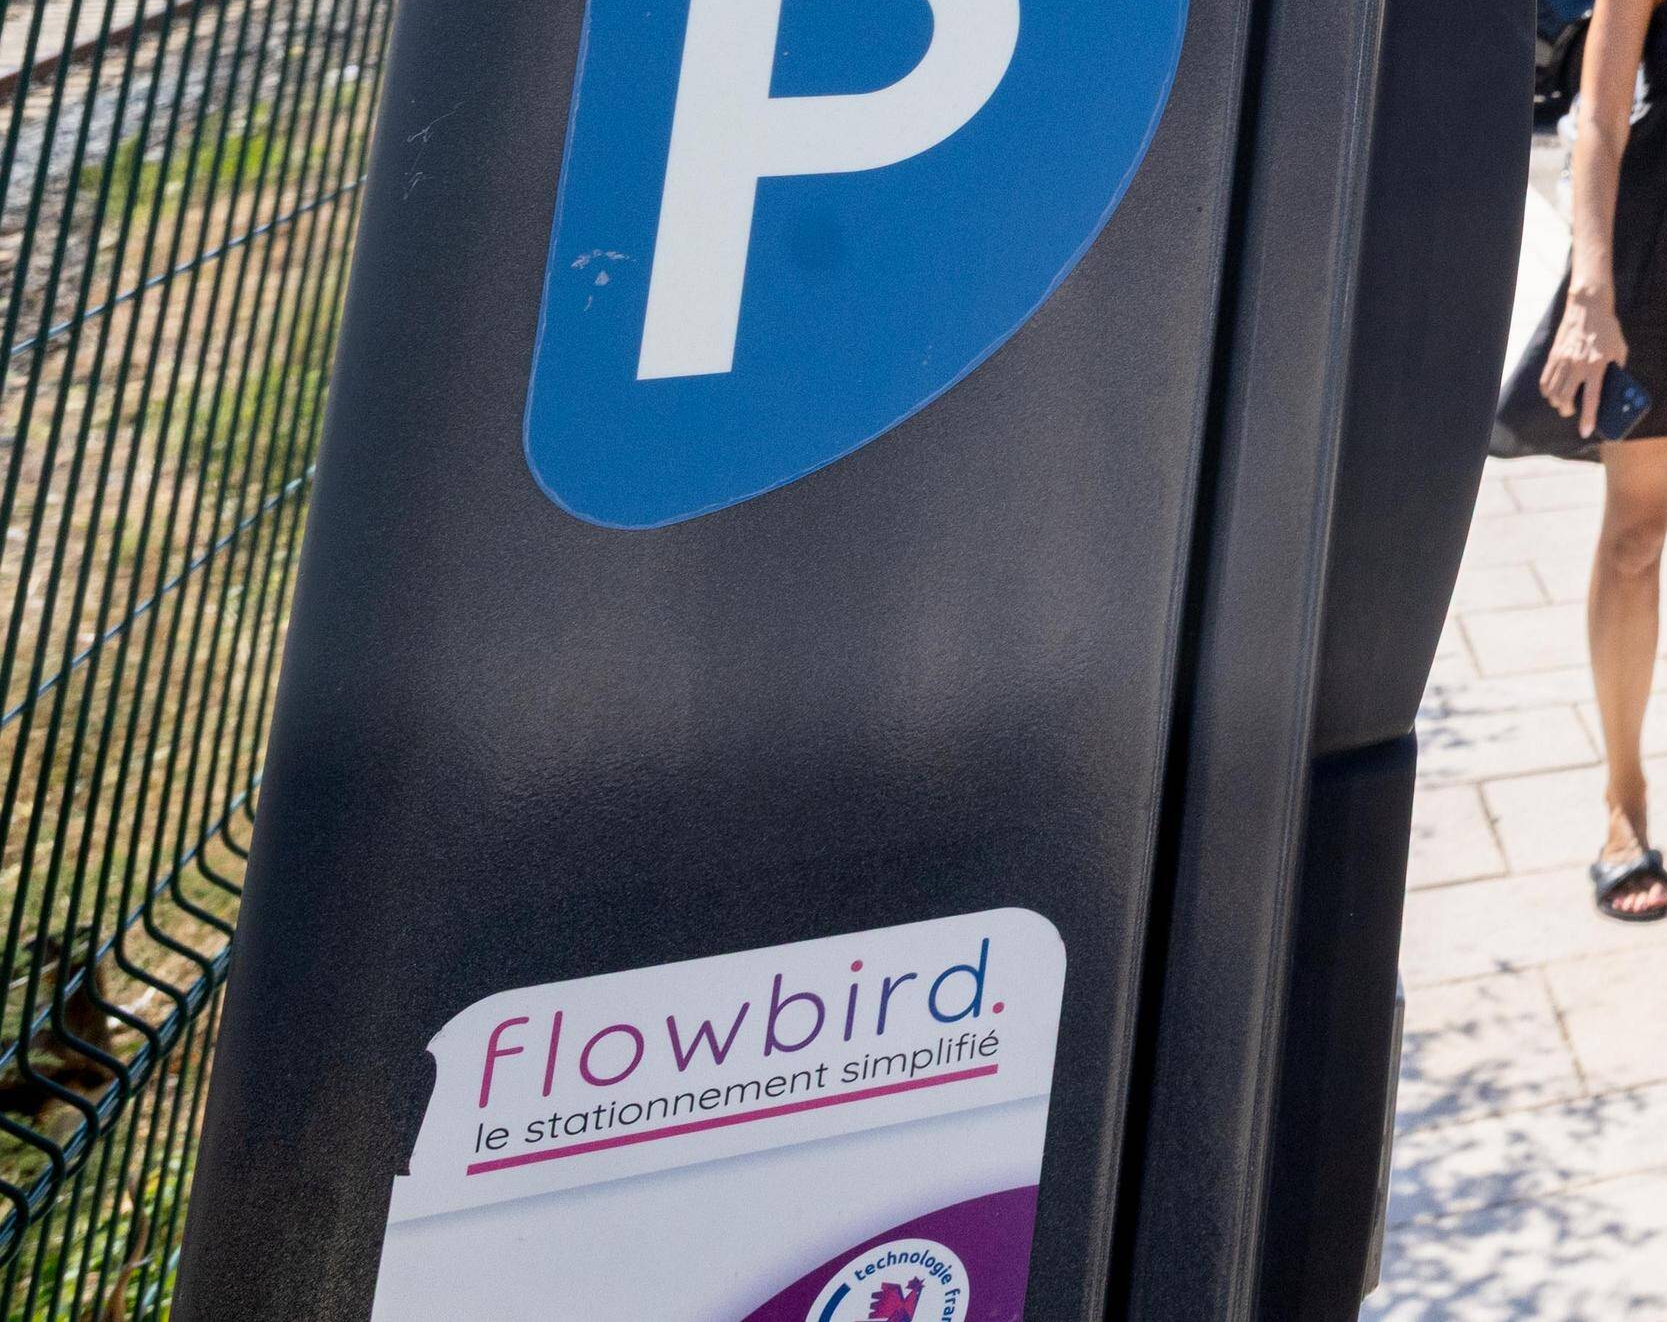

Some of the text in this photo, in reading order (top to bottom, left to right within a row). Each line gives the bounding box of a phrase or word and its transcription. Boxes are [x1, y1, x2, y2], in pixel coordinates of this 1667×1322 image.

[474, 1028, 1002, 1154] le stationnement simplifié
[854, 1249, 953, 1286] technologie
